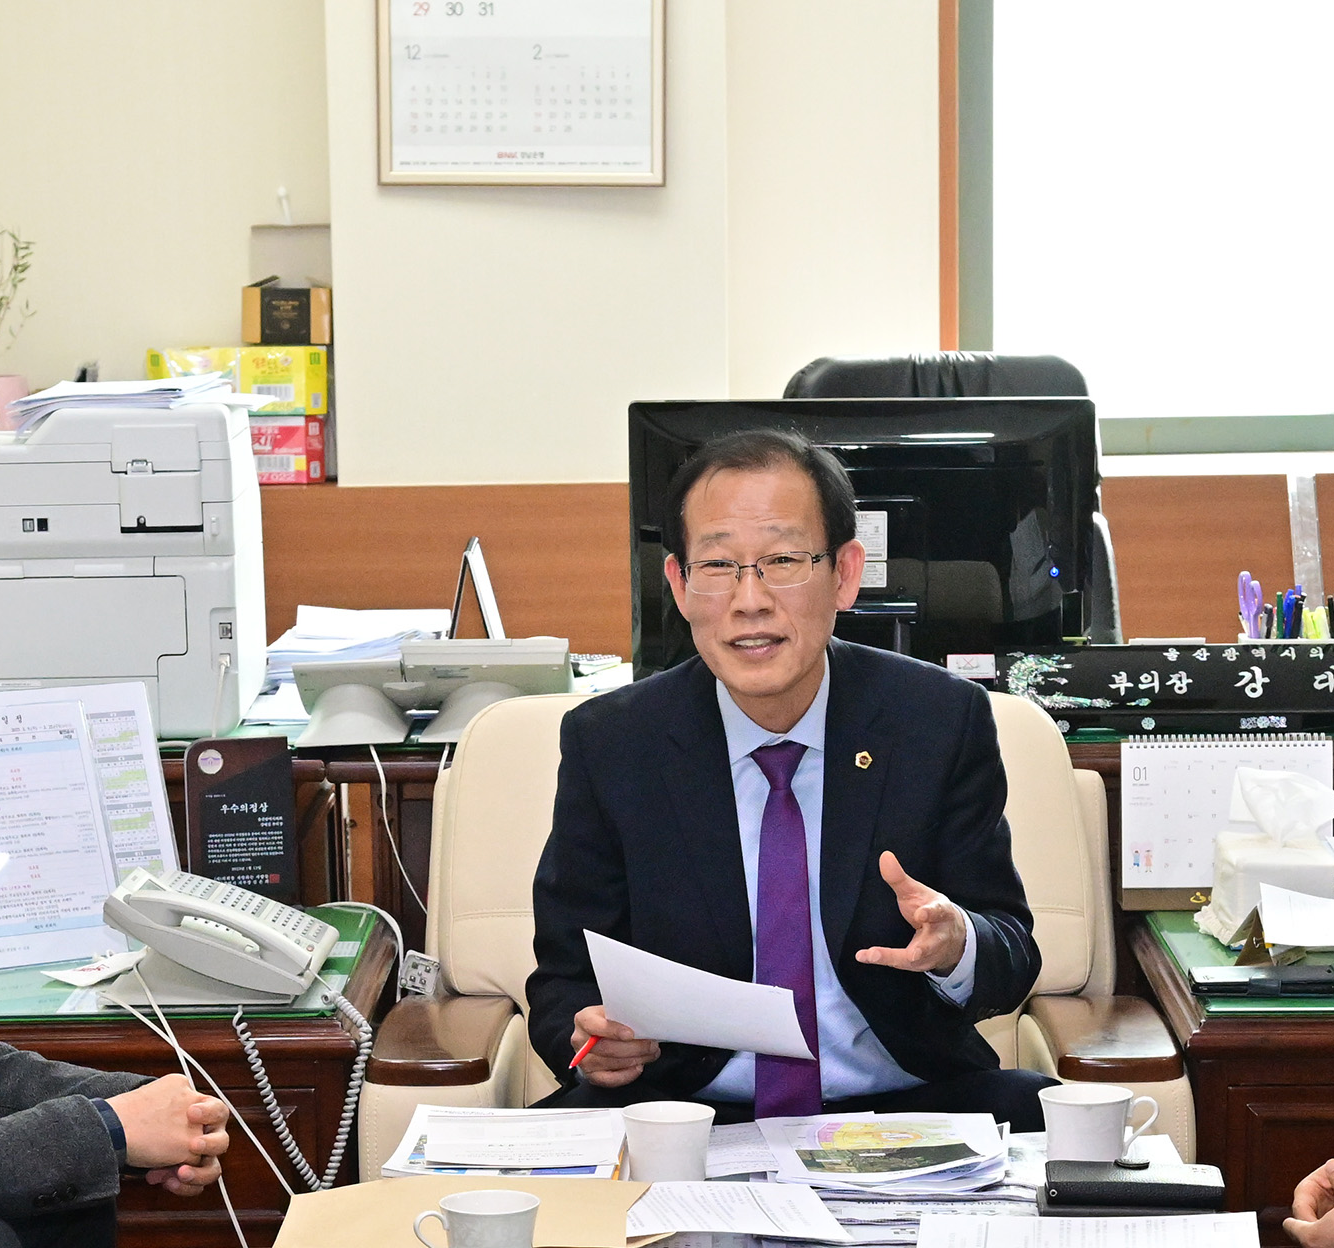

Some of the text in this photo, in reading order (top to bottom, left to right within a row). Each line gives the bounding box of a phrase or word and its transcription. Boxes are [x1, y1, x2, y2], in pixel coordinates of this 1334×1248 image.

[413, 2, 495, 16] 29 30 31
[405, 45, 421, 60] 12
[533, 44, 543, 60] 2
[1107, 671, 1193, 697] 부의장
[1234, 666, 1270, 698] 강
[1133, 766, 1147, 781] 01
[220, 802, 269, 814] 우수의정상
